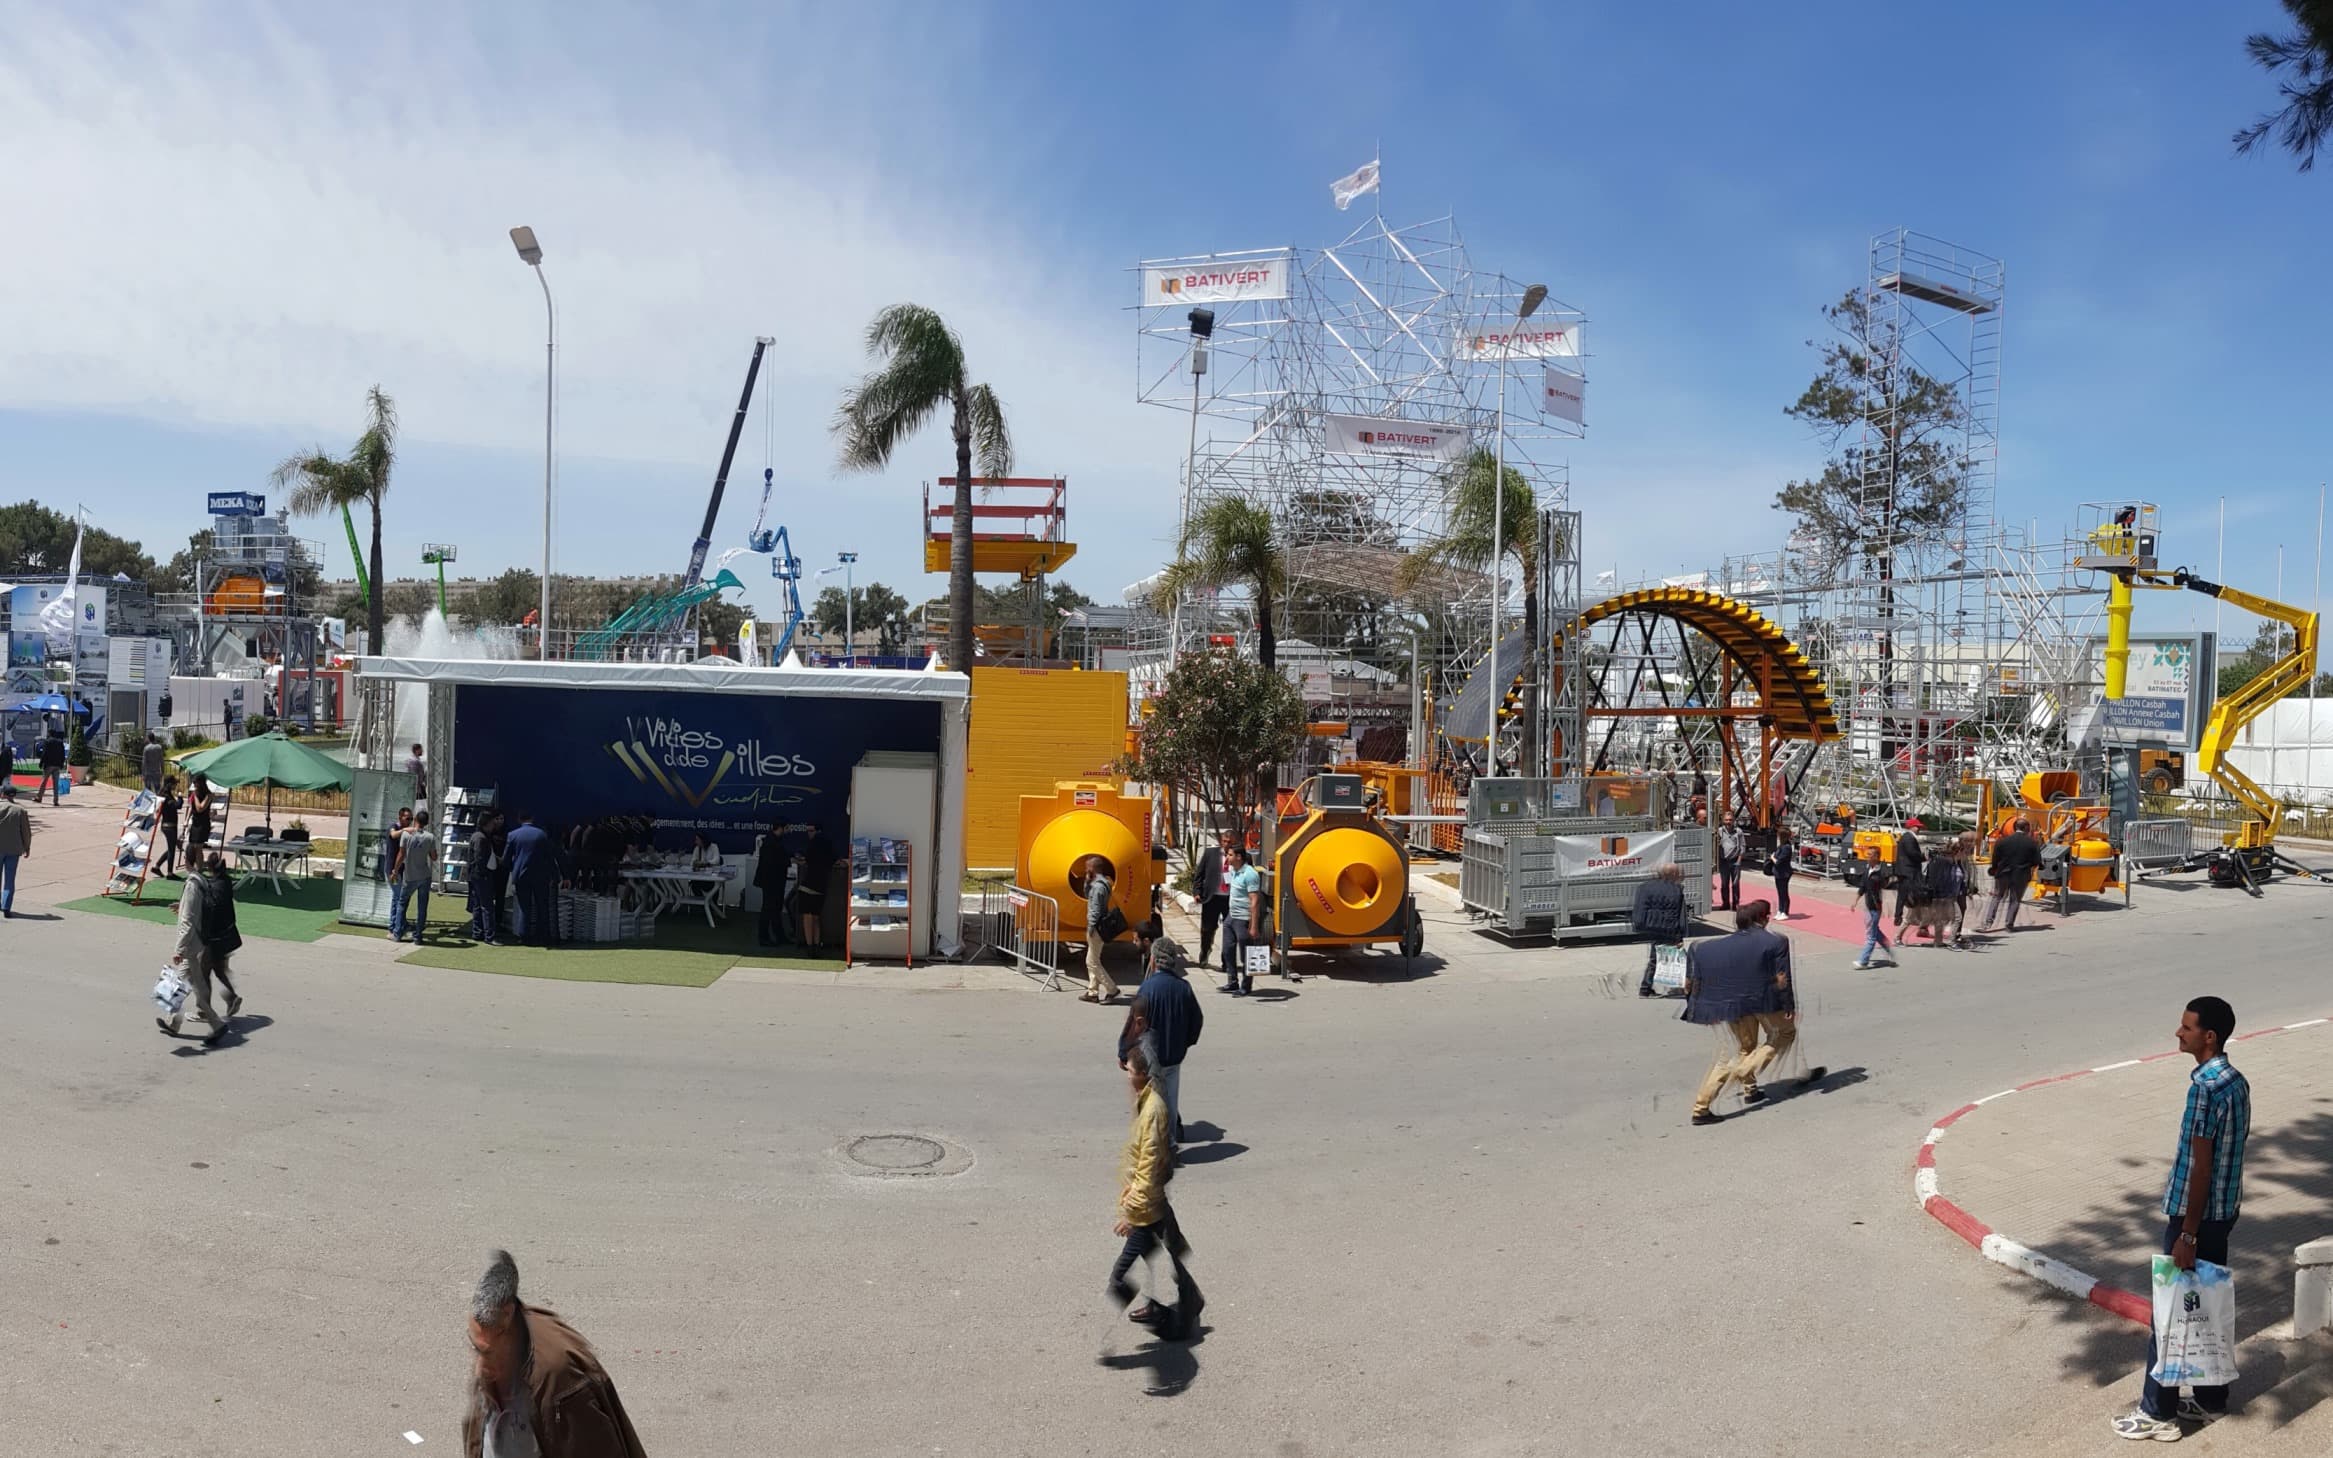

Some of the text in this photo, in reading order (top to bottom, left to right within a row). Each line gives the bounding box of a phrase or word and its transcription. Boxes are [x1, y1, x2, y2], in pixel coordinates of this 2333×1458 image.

[1185, 270, 1270, 288] BATIVERT
[1489, 331, 1564, 344] BATIVERT
[1377, 432, 1437, 445] BATIVERT
[210, 498, 244, 508] MEKA
[2141, 700, 2166, 709] Casbah
[2128, 708, 2153, 718] Annexe
[2154, 709, 2180, 719] Casbah
[2143, 719, 2164, 727] Union
[1588, 857, 1643, 867] BATIVERT
